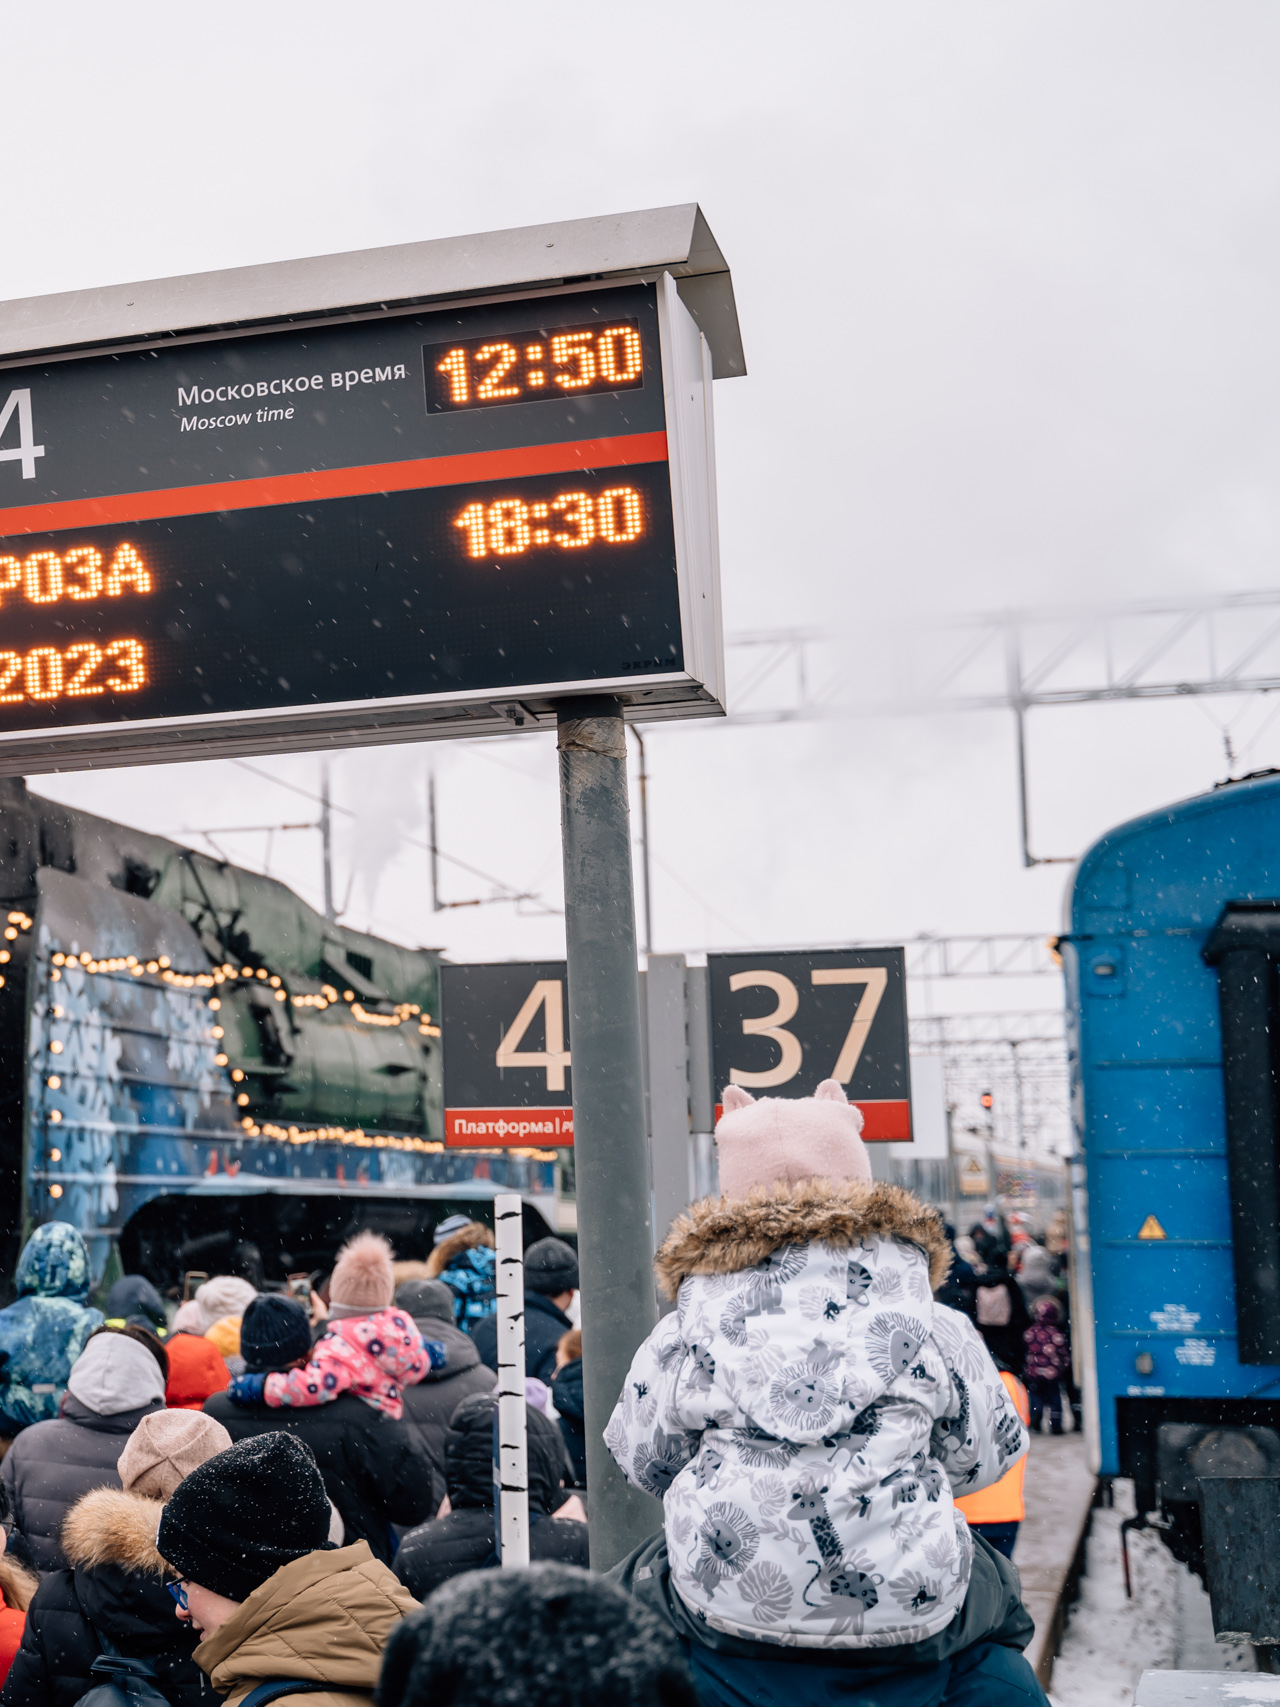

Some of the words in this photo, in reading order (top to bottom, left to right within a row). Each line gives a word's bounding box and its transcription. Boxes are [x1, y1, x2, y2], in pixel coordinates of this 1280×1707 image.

[177, 374, 324, 407] Московское
[330, 364, 407, 391] время
[437, 325, 642, 403] 12:50
[180, 413, 252, 432] Moscow
[256, 407, 295, 423] time
[454, 487, 641, 558] 18:30
[495, 979, 572, 1092] 4
[729, 967, 888, 1088] 37
[454, 1118, 554, 1138] Платформа
